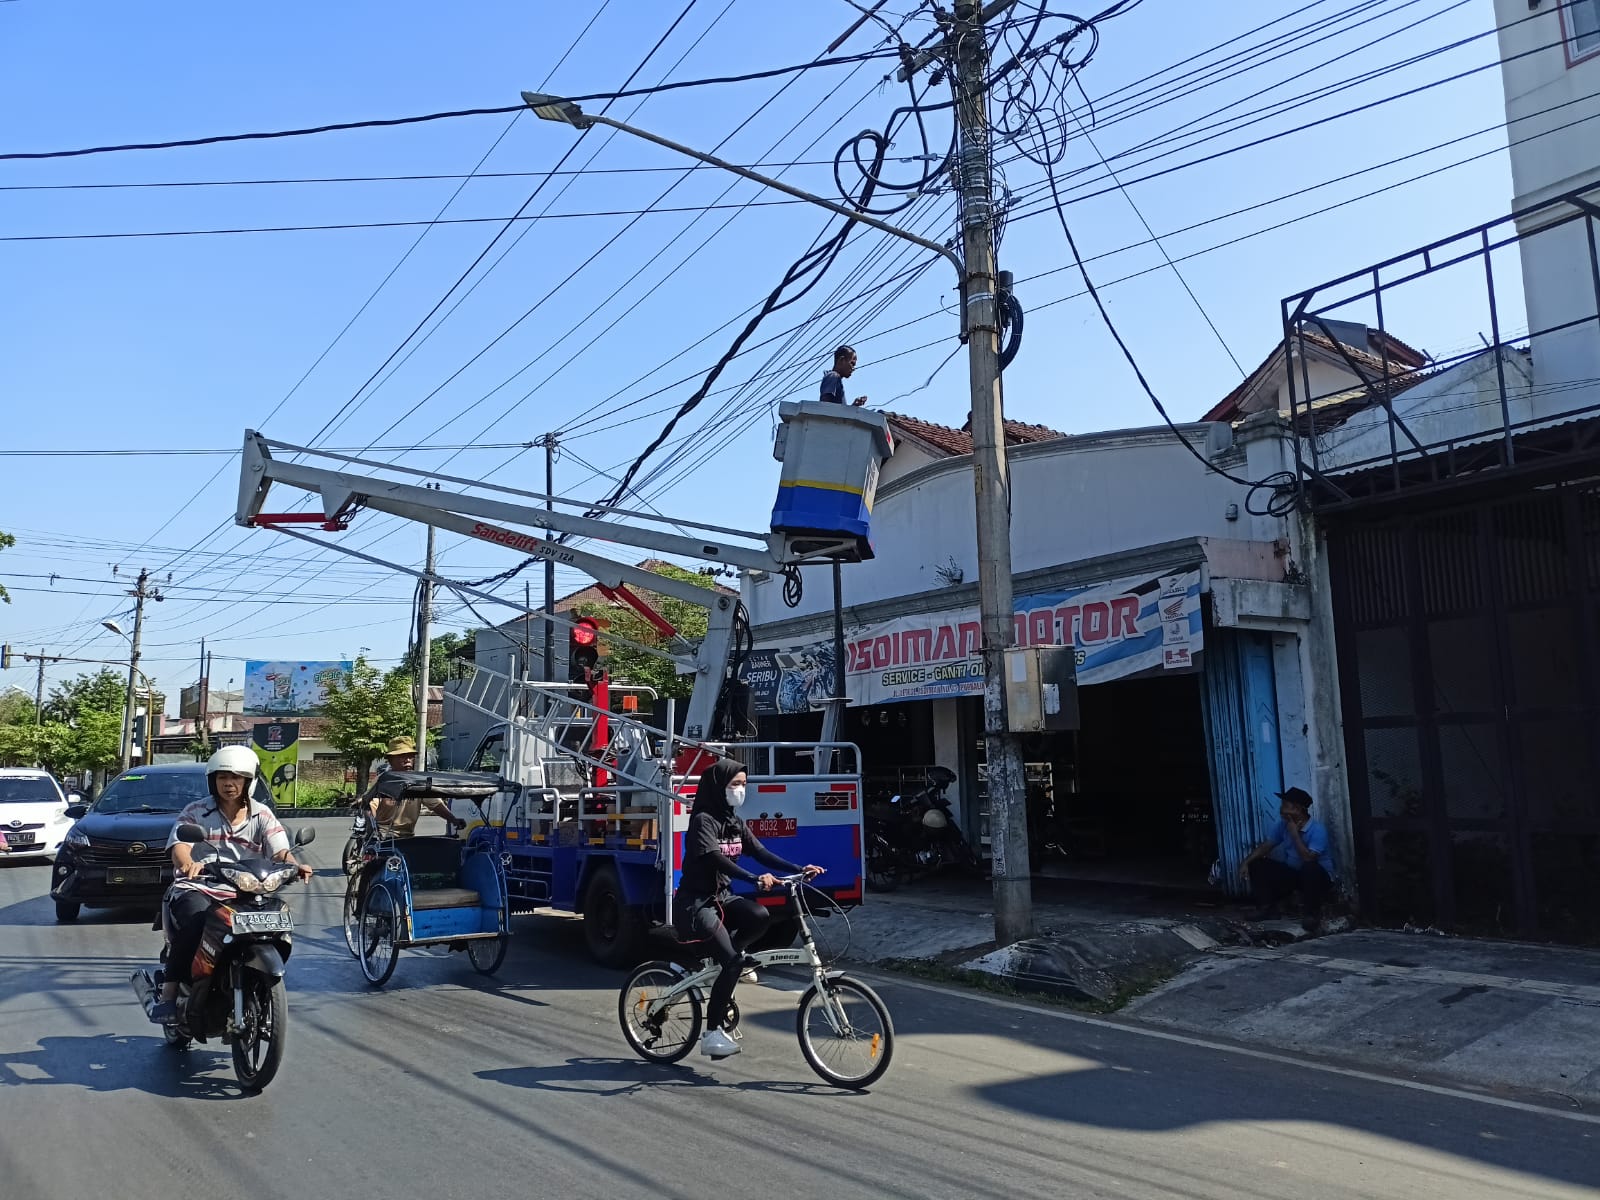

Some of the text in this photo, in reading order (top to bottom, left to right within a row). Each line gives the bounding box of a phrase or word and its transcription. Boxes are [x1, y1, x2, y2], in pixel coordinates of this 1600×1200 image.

[471, 522, 575, 563] Sandelift SDV 12A
[746, 669, 778, 683] SERIBU
[882, 668, 926, 686] SERVICE
[933, 663, 967, 681] GANTI
